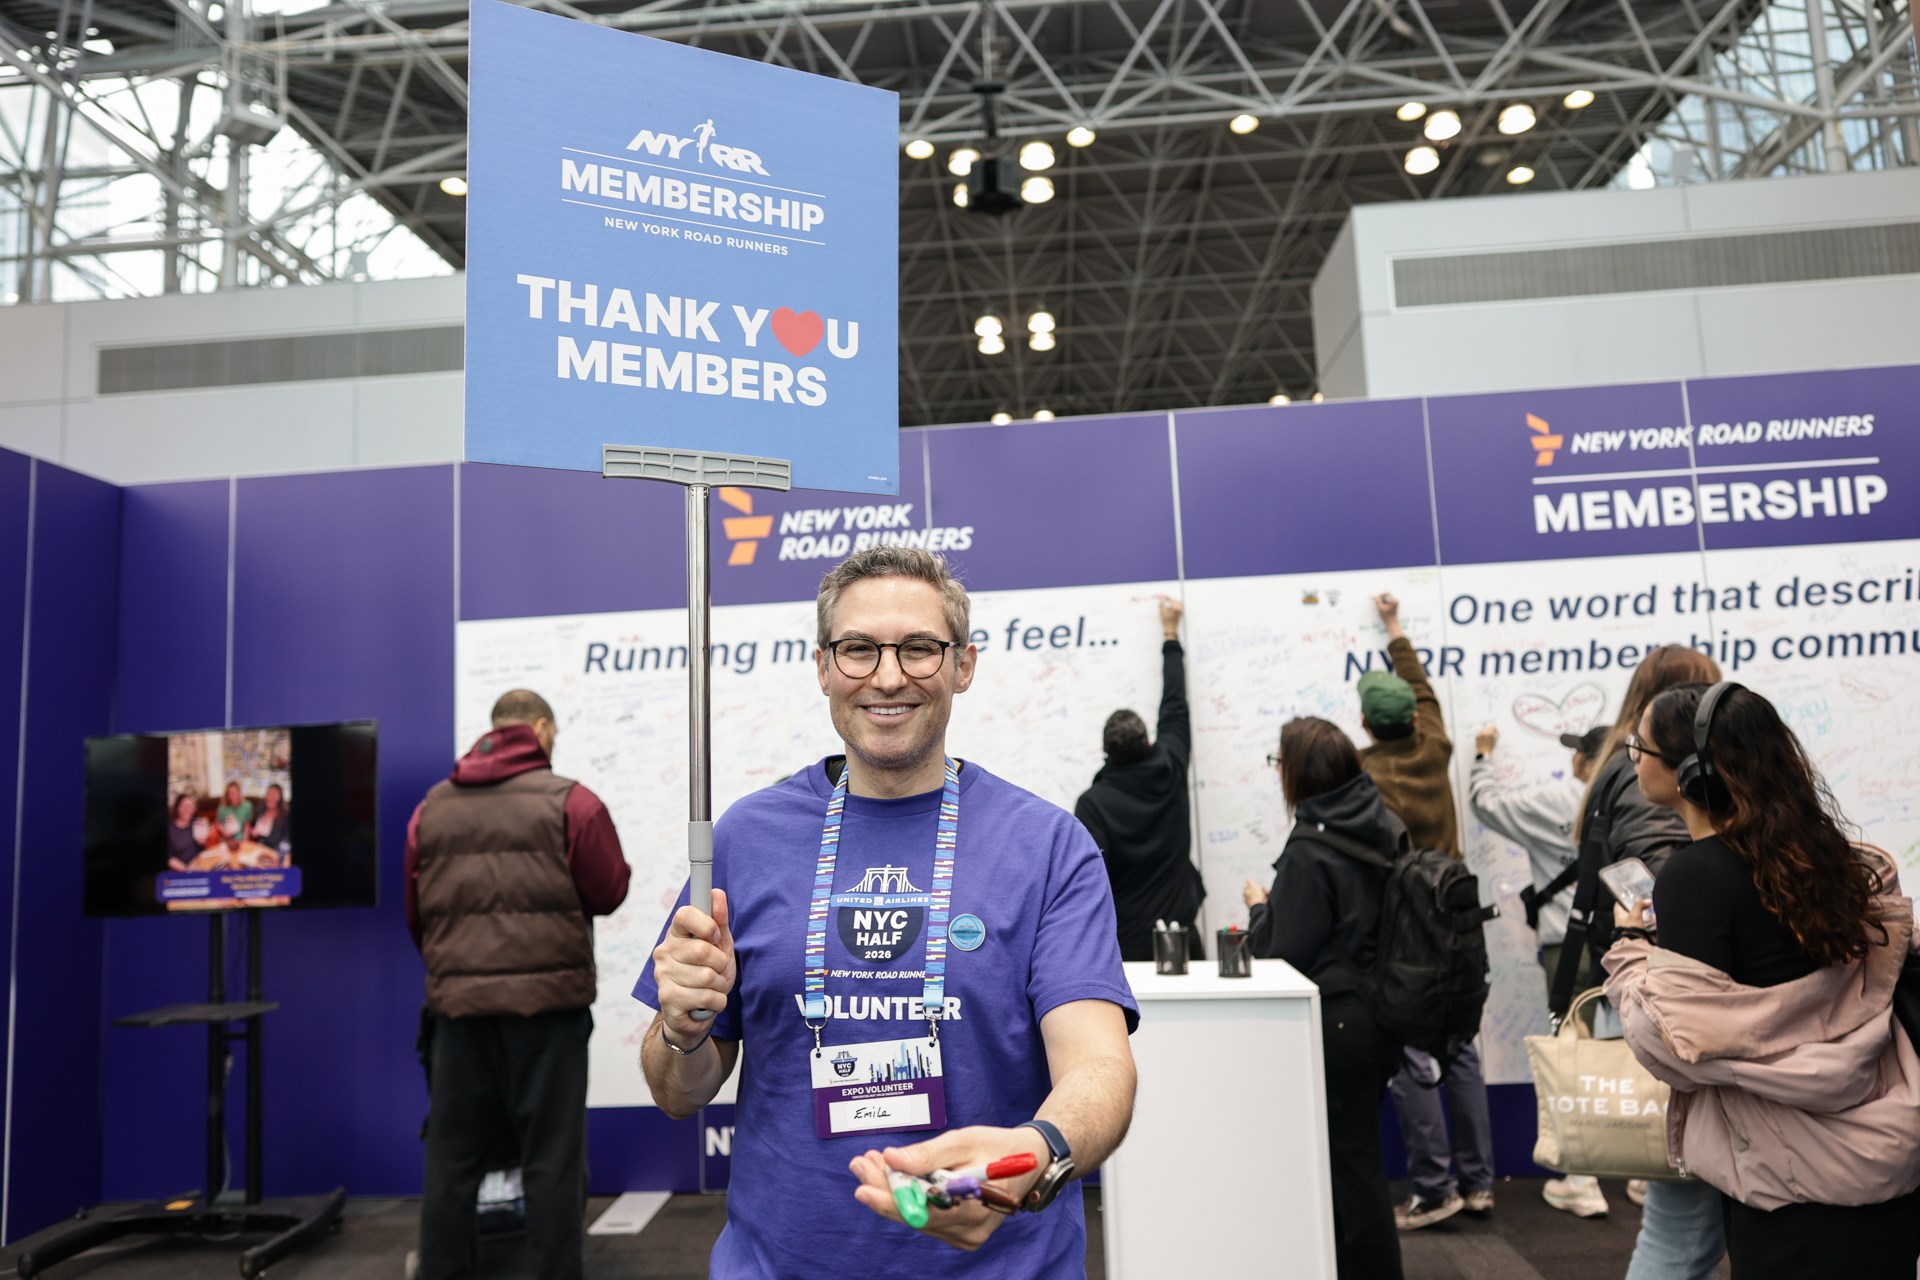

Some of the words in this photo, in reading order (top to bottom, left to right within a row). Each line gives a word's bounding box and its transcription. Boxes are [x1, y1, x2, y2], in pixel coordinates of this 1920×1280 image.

[626, 129, 771, 177] NYRR
[561, 158, 825, 232] MEMBERSHIP
[604, 216, 638, 232] NEW
[641, 222, 680, 239] YORK
[684, 229, 723, 245] ROAD
[726, 236, 789, 256] RUNNERS
[516, 273, 721, 343] THANK
[557, 335, 827, 407] MEMBERS
[1570, 429, 1627, 455] NEW
[1629, 424, 1695, 451] YORK
[1697, 420, 1763, 446] ROAD
[1765, 413, 1875, 442] RUNNERS
[778, 506, 841, 535] NEW
[843, 502, 914, 532] YORK
[1533, 474, 1889, 535] MEMBERSHIP
[778, 532, 850, 561] ROAD
[852, 526, 975, 555] RUNNERS
[1449, 594, 1534, 625] One
[1549, 583, 1658, 621] word
[1672, 580, 1762, 614] that
[1775, 568, 1920, 608] descri
[584, 640, 758, 674] Runnng
[1005, 615, 1119, 651] feel...
[836, 896, 873, 905] UNITED
[884, 896, 930, 905] AIRLINES
[853, 909, 908, 931] NYC
[856, 931, 903, 947] HALF
[864, 950, 892, 959] 2026
[830, 969, 852, 978] NEW
[851, 970, 874, 979] YORK
[875, 971, 898, 979] ROAD
[898, 970, 926, 980] RUNNE
[837, 1062, 852, 1070] NYC
[841, 1087, 864, 1097] EXPO
[865, 1082, 914, 1095] VOLUNTEER
[1578, 1075, 1636, 1095] THE
[1546, 1095, 1610, 1116] TOTE
